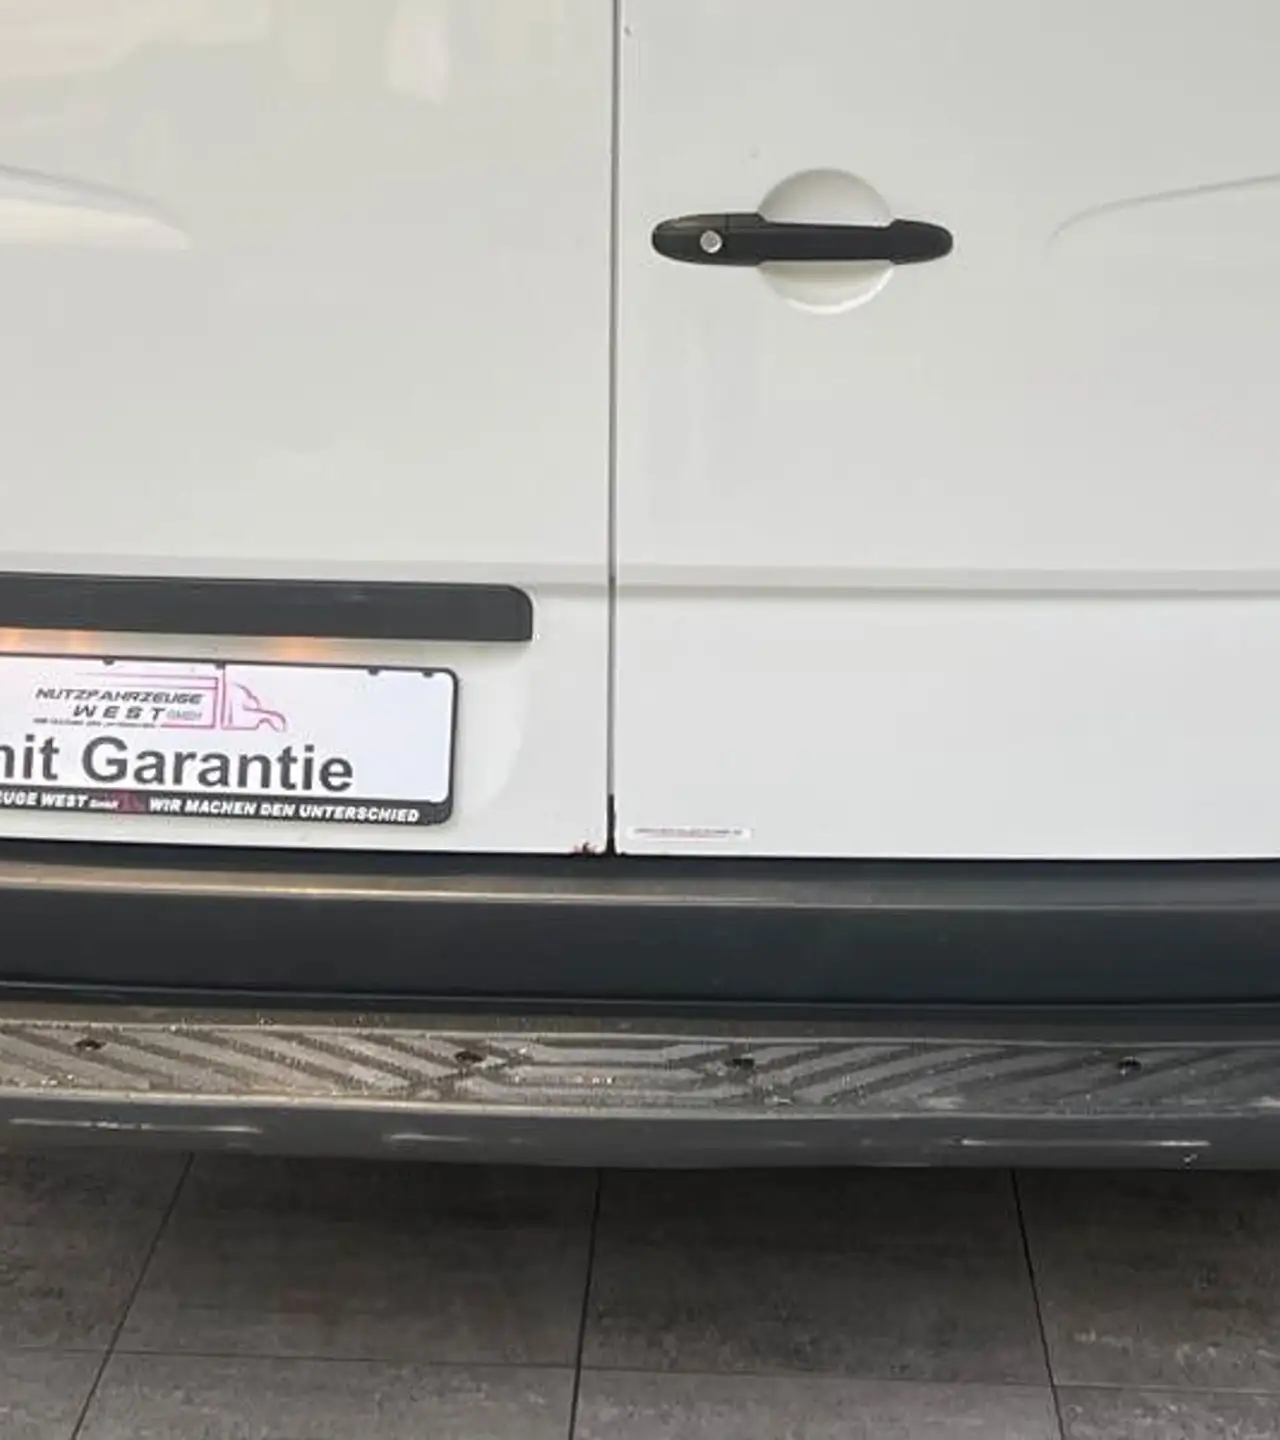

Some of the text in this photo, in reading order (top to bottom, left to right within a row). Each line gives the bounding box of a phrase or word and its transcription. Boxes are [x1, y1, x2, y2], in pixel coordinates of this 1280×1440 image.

[35, 688, 204, 705] NUTZFAHRZEUGE
[73, 704, 165, 722] WEST
[82, 735, 353, 792] Garantie
[41, 792, 89, 809] WEST
[149, 797, 181, 813] WIR
[184, 799, 261, 816] MACHEN
[261, 803, 297, 818] DEN
[299, 804, 420, 823] UNTERSCHIED
